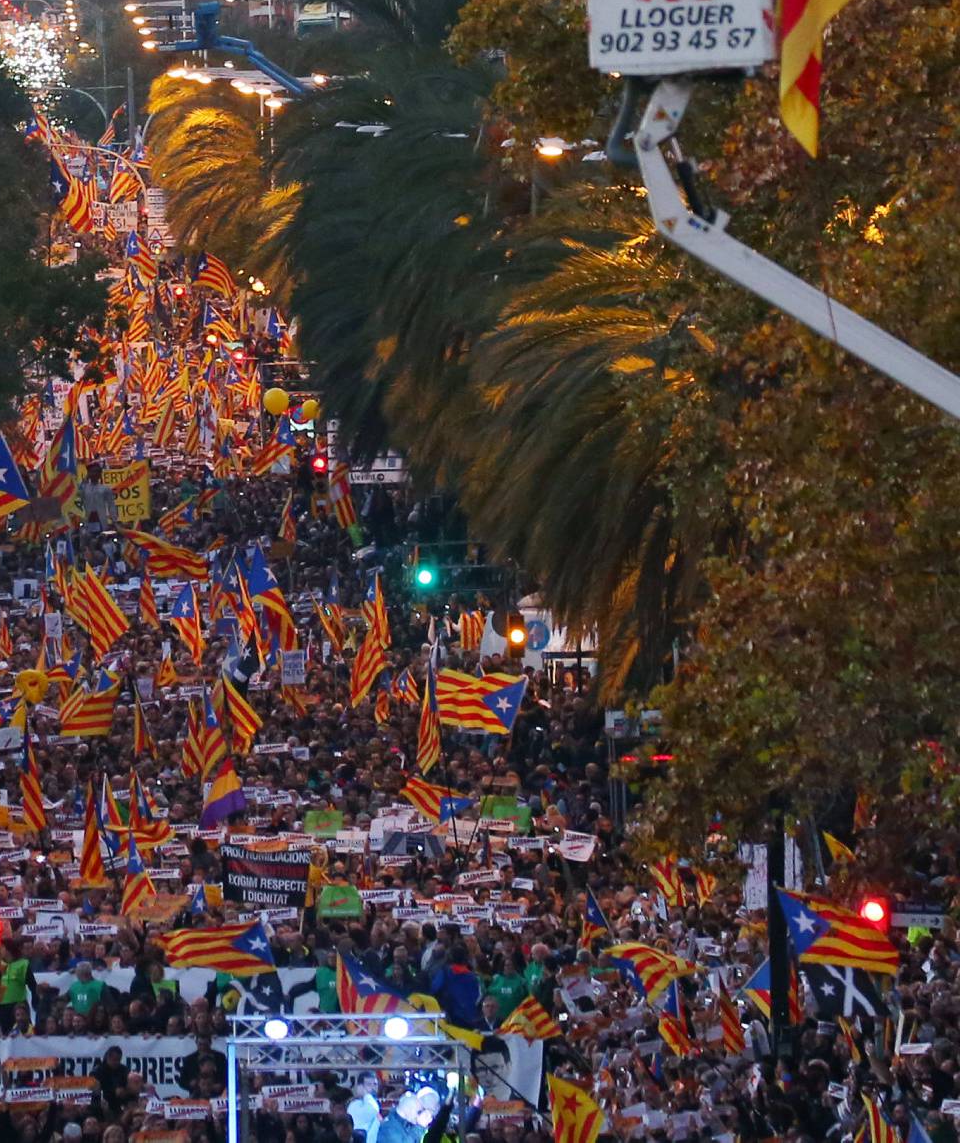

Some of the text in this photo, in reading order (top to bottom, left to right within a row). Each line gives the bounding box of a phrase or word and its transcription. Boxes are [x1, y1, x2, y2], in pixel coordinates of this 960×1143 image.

[621, 5, 734, 28] LLOGUER
[600, 28, 756, 53] 902 93 45 67
[221, 844, 244, 859] PROU
[260, 878, 307, 893] RESPECTE
[248, 890, 290, 905] DIGNITAT
